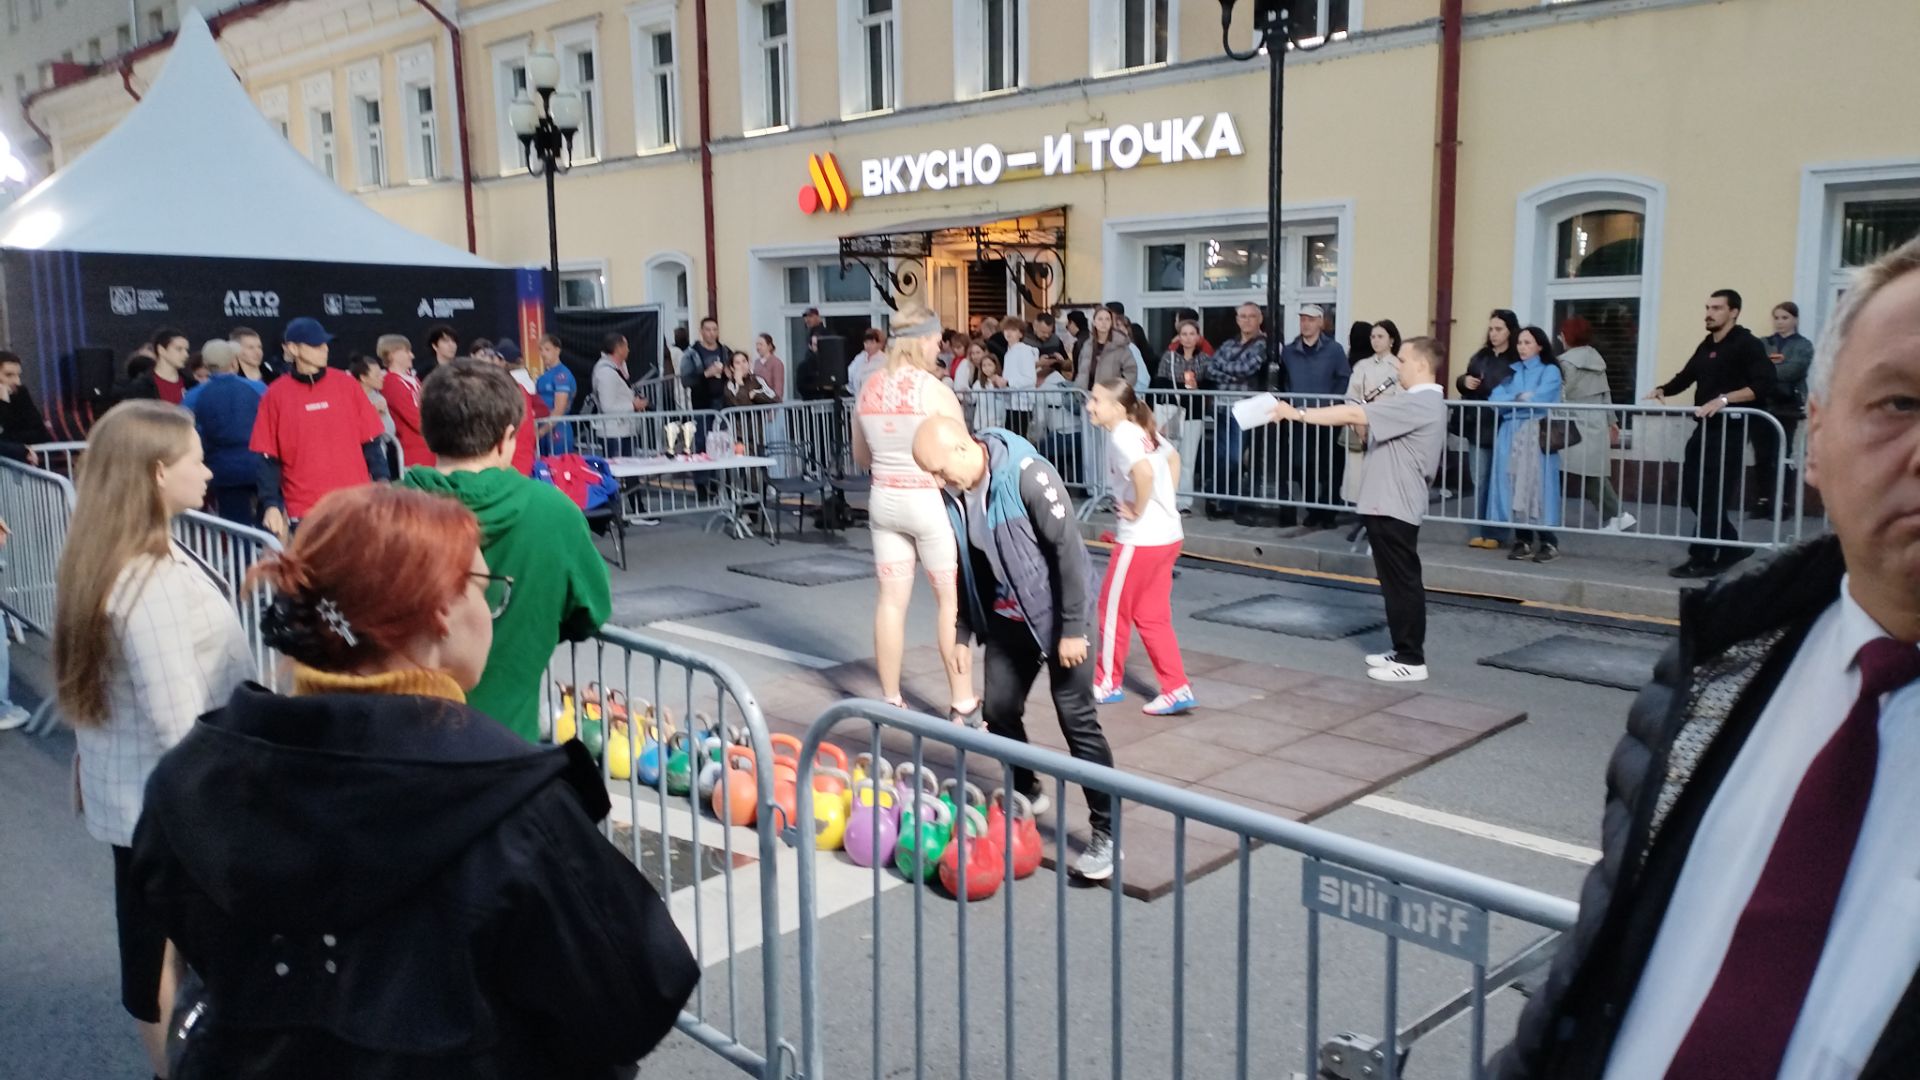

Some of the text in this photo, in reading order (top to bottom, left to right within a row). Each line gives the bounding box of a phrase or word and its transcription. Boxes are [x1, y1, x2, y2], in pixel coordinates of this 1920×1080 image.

[861, 142, 1003, 198] ВКУСНО
[1043, 132, 1074, 176] И
[1083, 111, 1244, 171] ТОЧКА
[1318, 874, 1469, 947] spinoff
